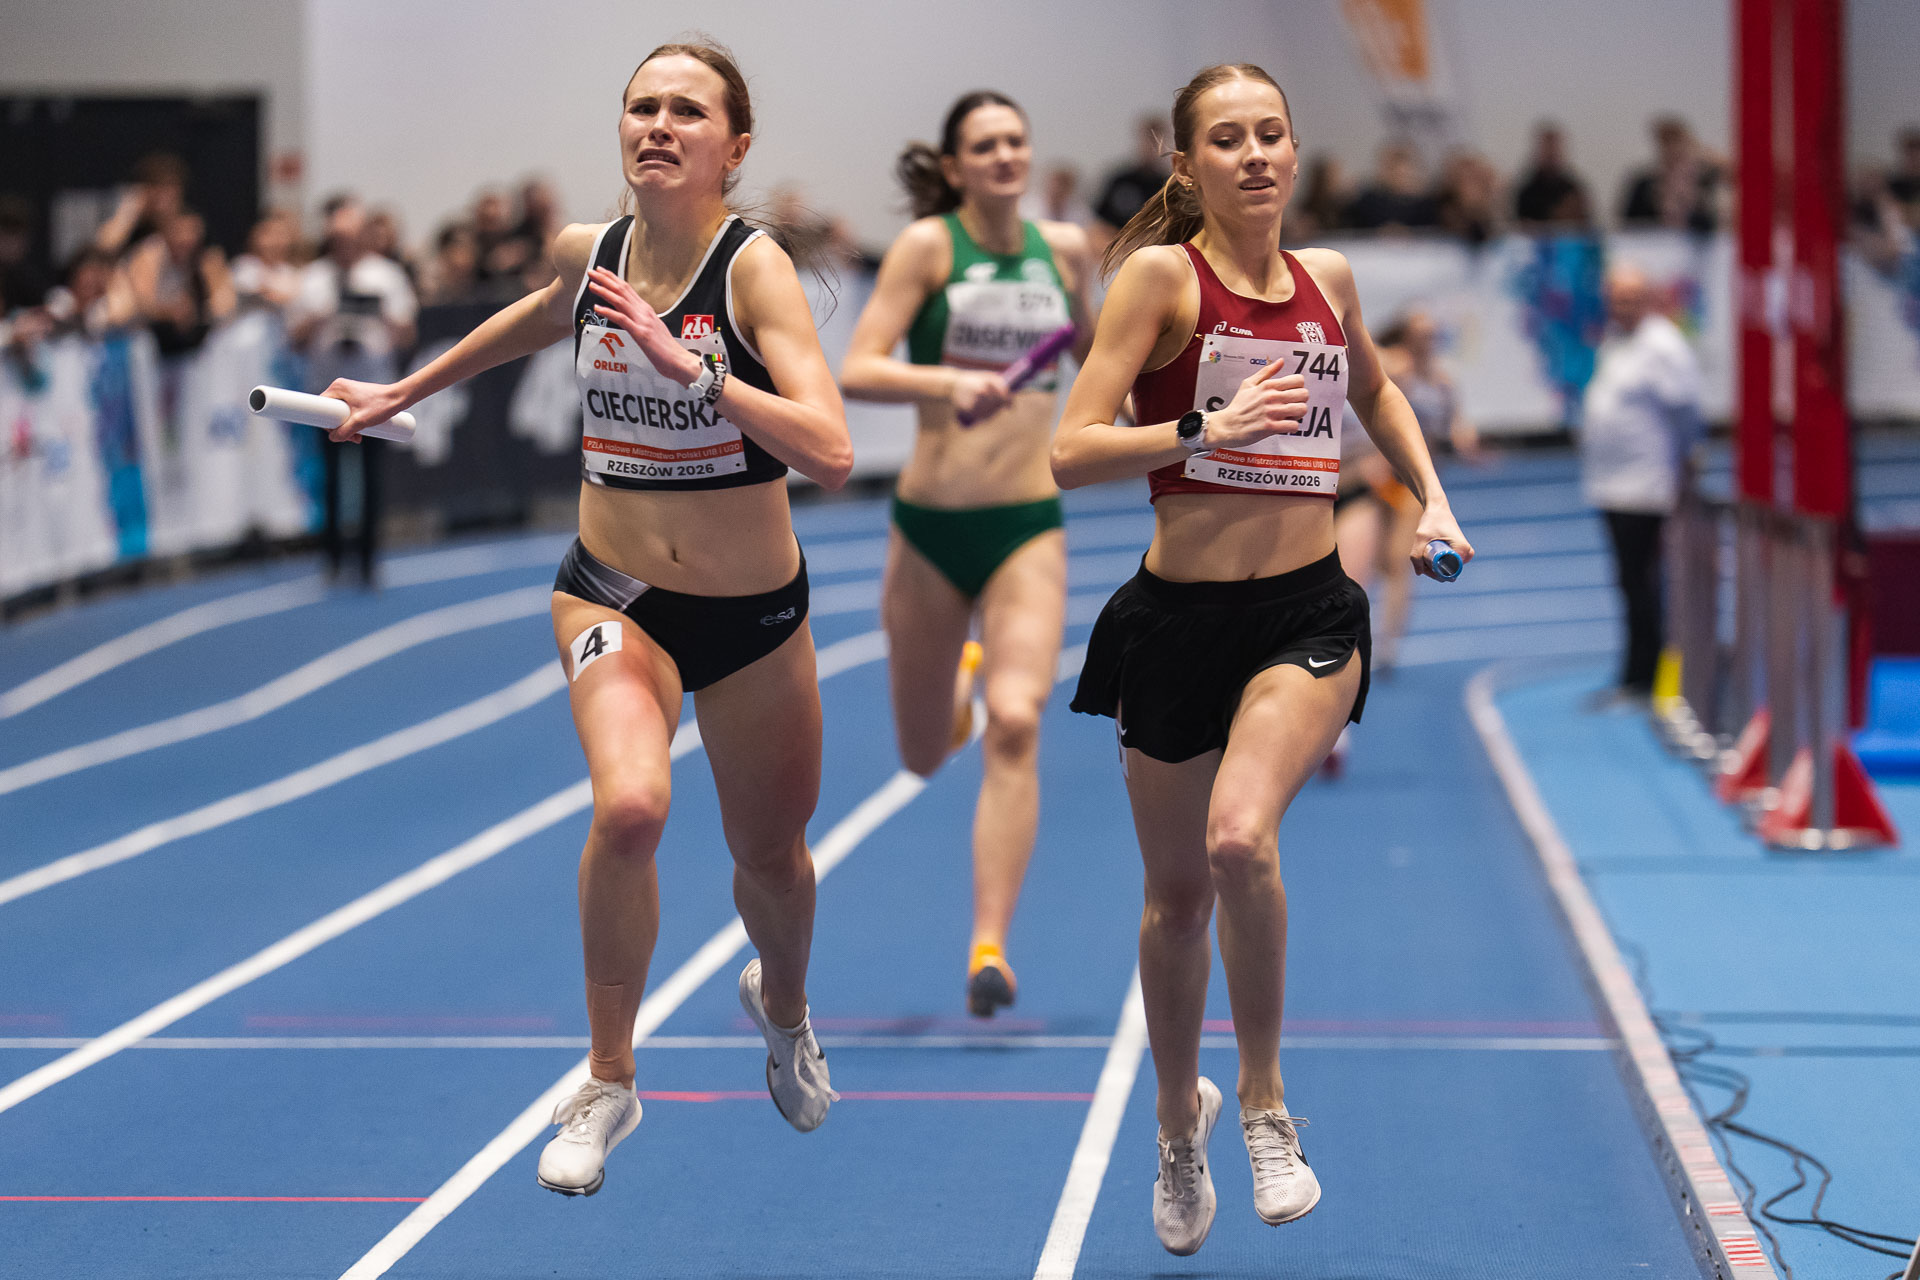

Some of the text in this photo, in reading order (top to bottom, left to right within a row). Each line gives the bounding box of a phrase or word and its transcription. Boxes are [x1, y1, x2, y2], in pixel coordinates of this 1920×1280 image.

[593, 359, 628, 374] ORLEN
[1292, 350, 1340, 381] 744
[587, 440, 604, 450] PZLA
[604, 443, 631, 454] Halowe
[631, 446, 675, 460] Mistrzostwa
[676, 450, 701, 460] Polski
[703, 448, 718, 457] U18
[724, 443, 740, 453] U20
[607, 459, 714, 477] RZESZÓW 2026
[1214, 452, 1246, 463] Halowe
[1247, 456, 1292, 467] Mistrzostwa
[1293, 459, 1312, 468] Polski
[1312, 461, 1324, 469] U18
[1327, 462, 1338, 470] U20
[1217, 467, 1321, 487] RZESZÓW 2026
[580, 625, 609, 664] 4
